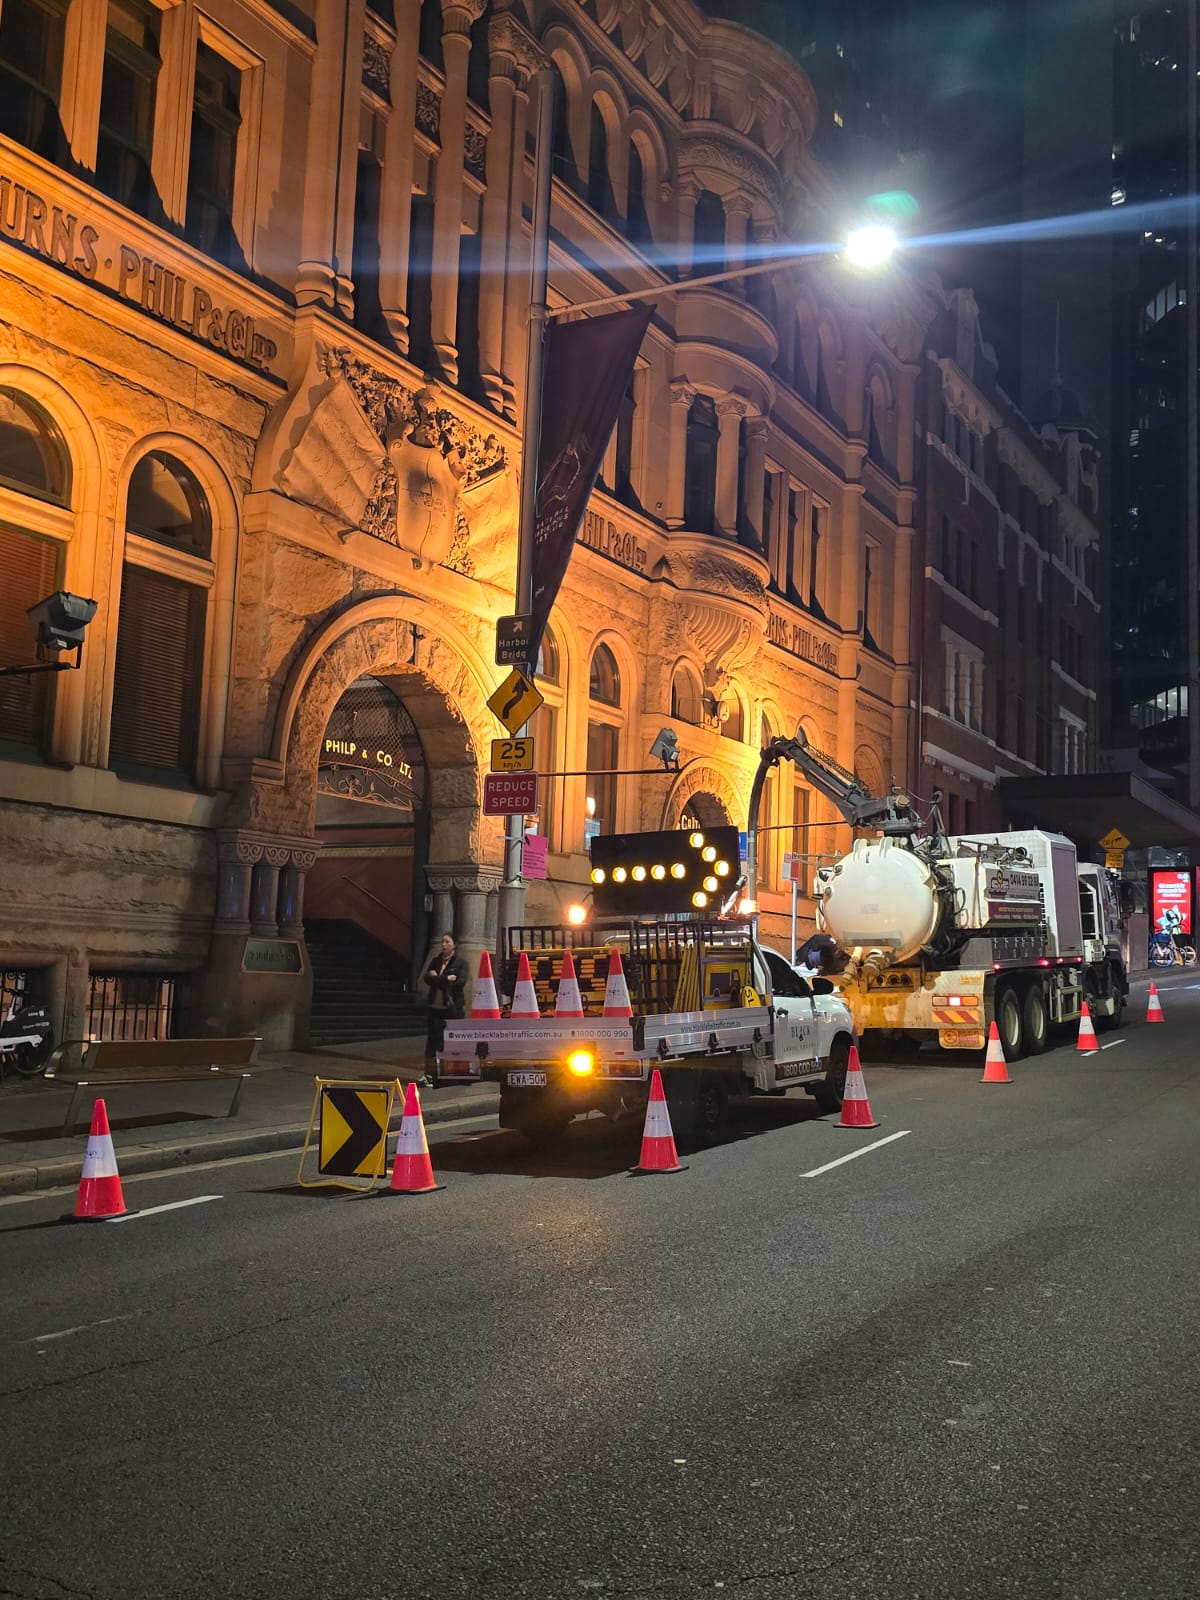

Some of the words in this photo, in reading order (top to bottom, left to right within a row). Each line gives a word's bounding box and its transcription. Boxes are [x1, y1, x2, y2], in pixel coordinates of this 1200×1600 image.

[325, 739, 357, 756] PHILP
[361, 749, 368, 759] &
[501, 741, 526, 760] 25
[503, 761, 522, 770] km/h
[488, 780, 535, 792] REDUCE
[491, 796, 530, 808] SPEED
[455, 1030, 562, 1039] www.blacklabeltraffic.com.au
[576, 1030, 595, 1038] 1800
[597, 1030, 611, 1038] 000
[613, 1030, 629, 1038] 990
